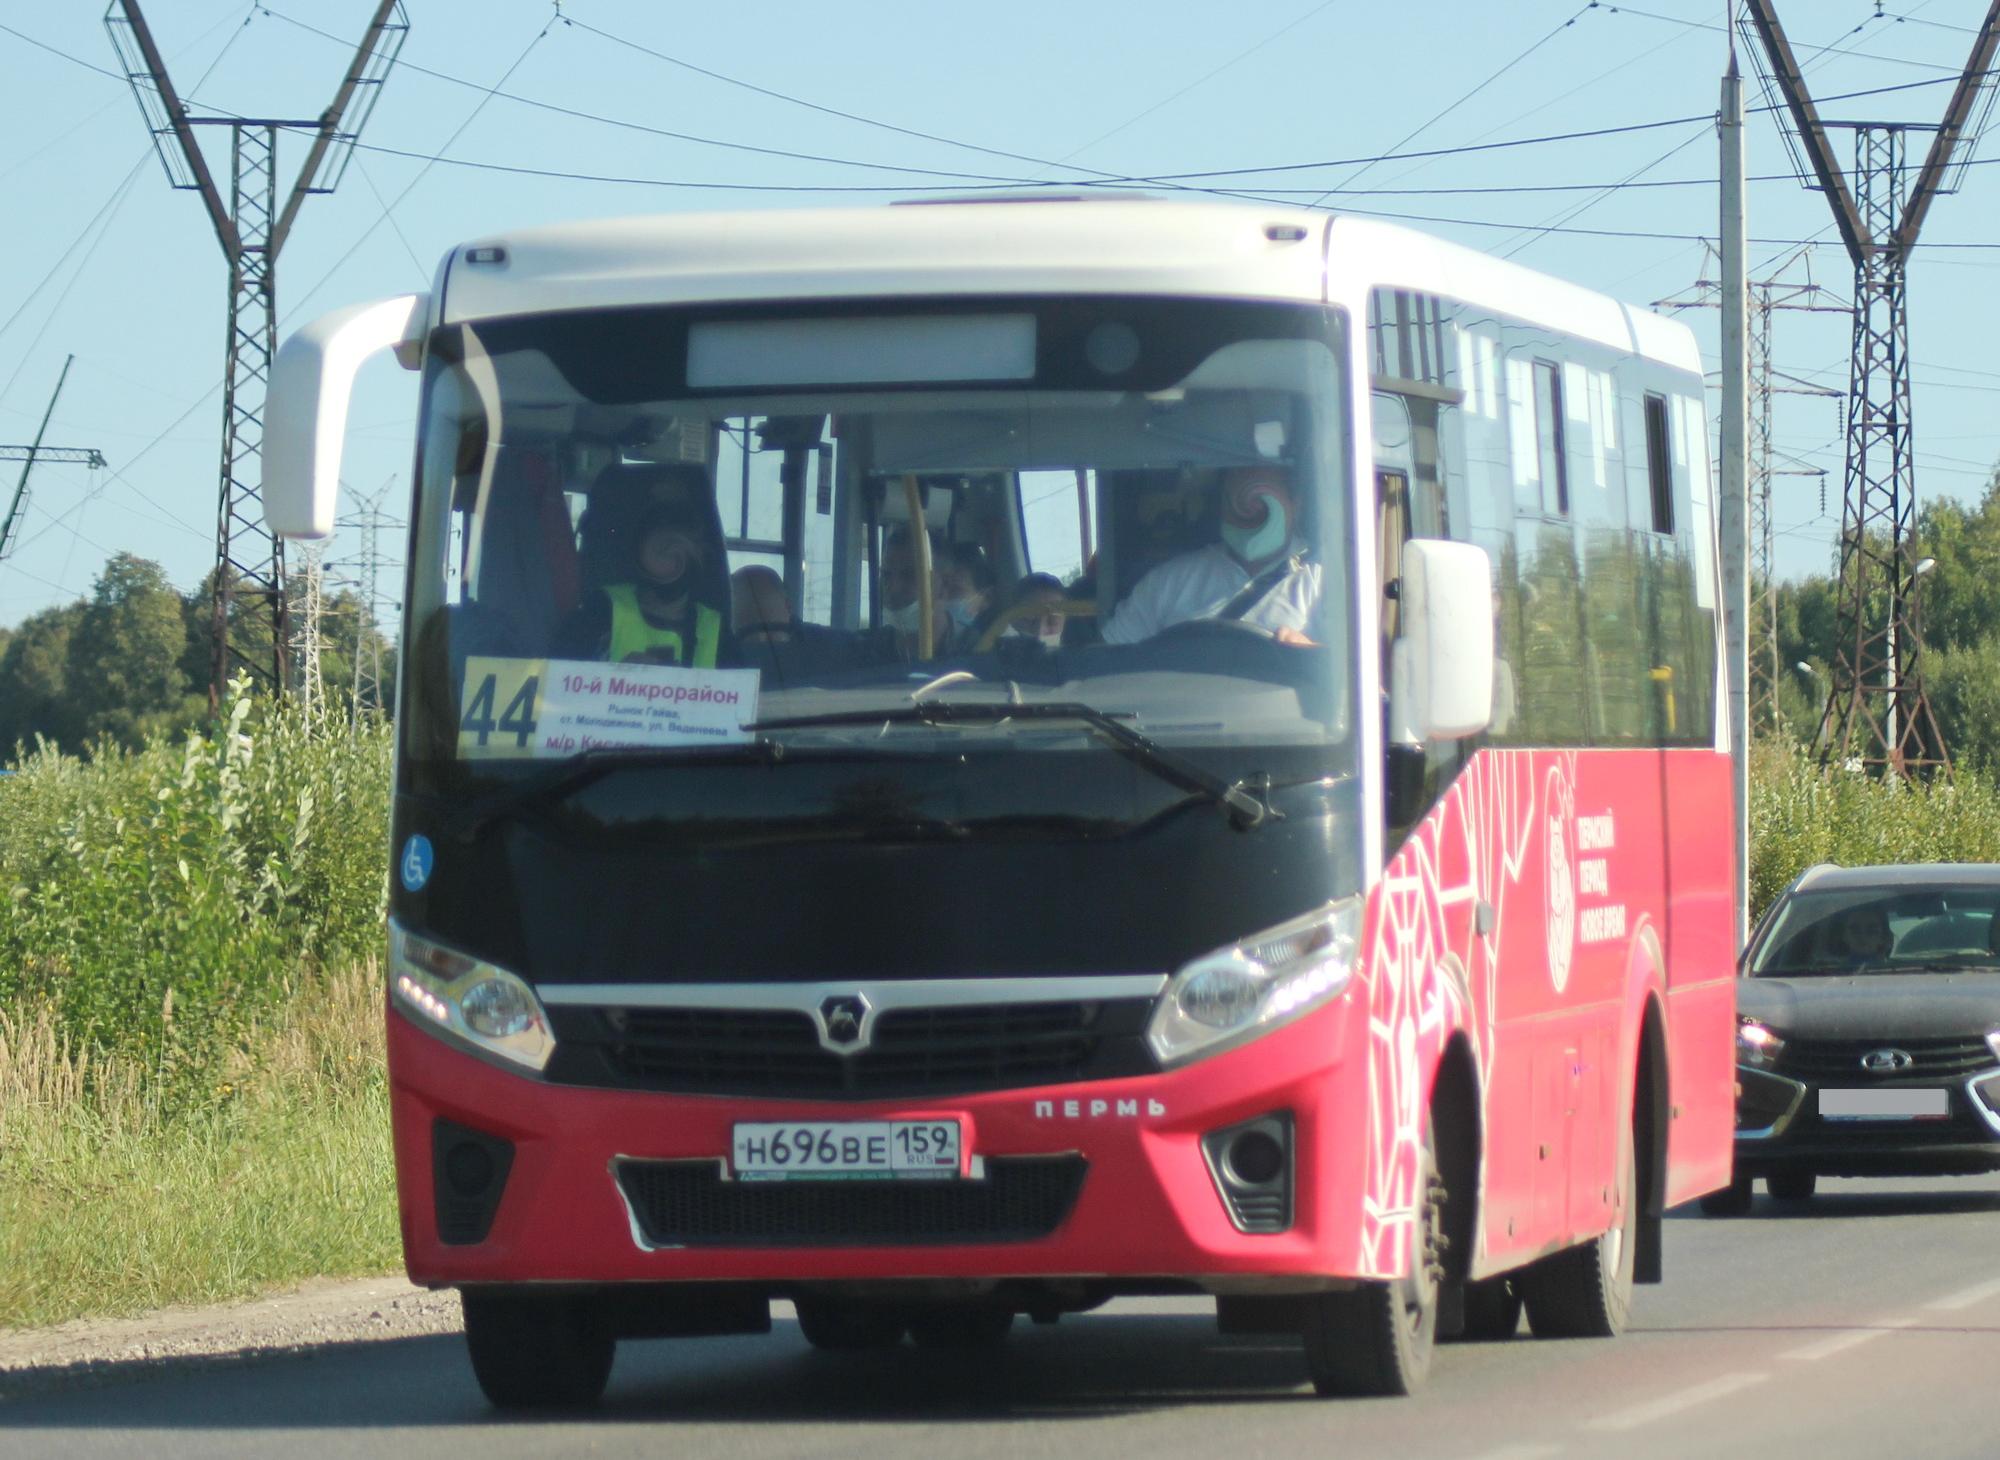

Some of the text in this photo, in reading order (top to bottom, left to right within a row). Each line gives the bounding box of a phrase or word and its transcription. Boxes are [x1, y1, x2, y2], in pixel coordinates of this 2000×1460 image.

[563, 675, 739, 704] 10-й Микрорайон
[460, 674, 539, 747] 44
[545, 734, 575, 753] м/р
[1036, 1099, 1165, 1117] ПЕРМЬ
[896, 1127, 949, 1154] 159
[907, 1154, 934, 1164] RUS
